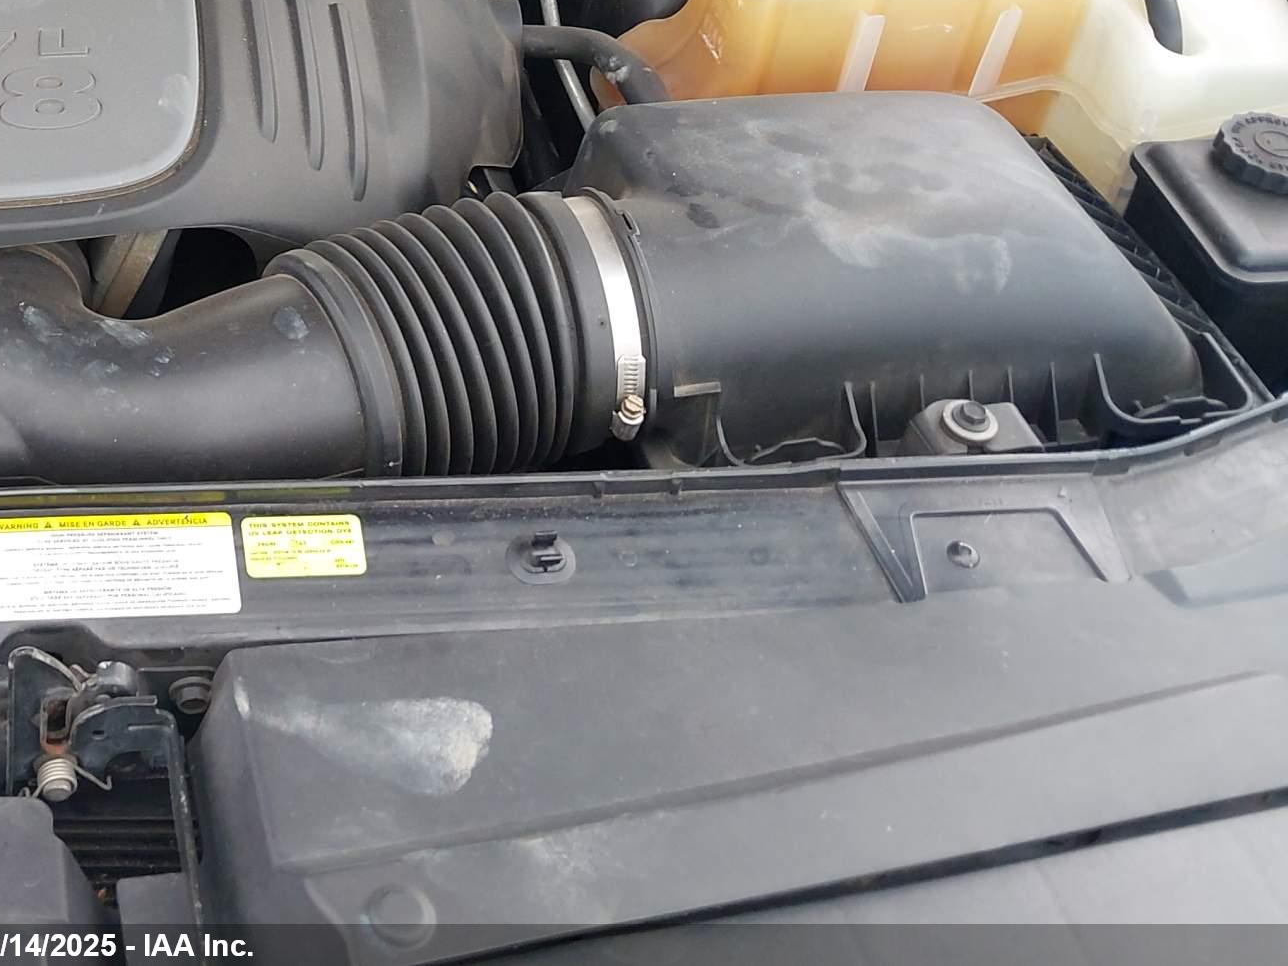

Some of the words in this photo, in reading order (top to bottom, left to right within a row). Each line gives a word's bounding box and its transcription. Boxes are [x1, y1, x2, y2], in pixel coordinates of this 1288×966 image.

[37, 26, 91, 58] L
[58, 520, 81, 528] MISE
[83, 520, 95, 528] EN
[96, 519, 127, 528] GARDE
[146, 517, 208, 527] ADVERTENCIA
